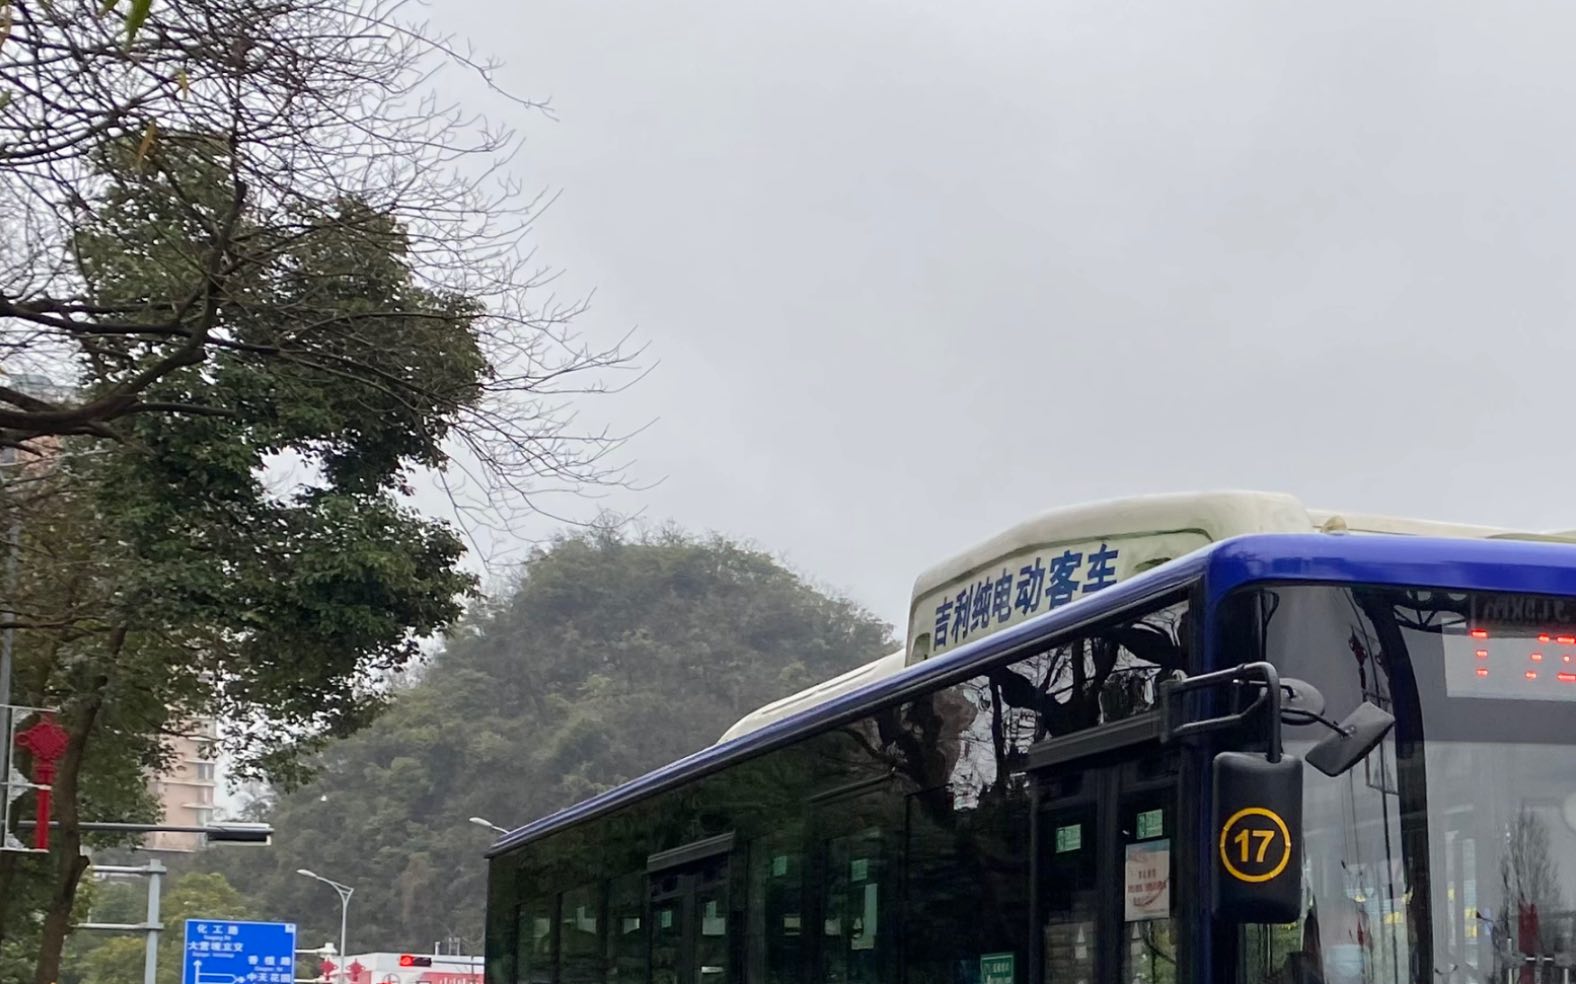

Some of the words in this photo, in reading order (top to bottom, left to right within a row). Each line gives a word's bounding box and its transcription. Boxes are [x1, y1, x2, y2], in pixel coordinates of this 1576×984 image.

[933, 543, 1119, 651] 吉利纯电动客车
[1234, 829, 1275, 862] 17
